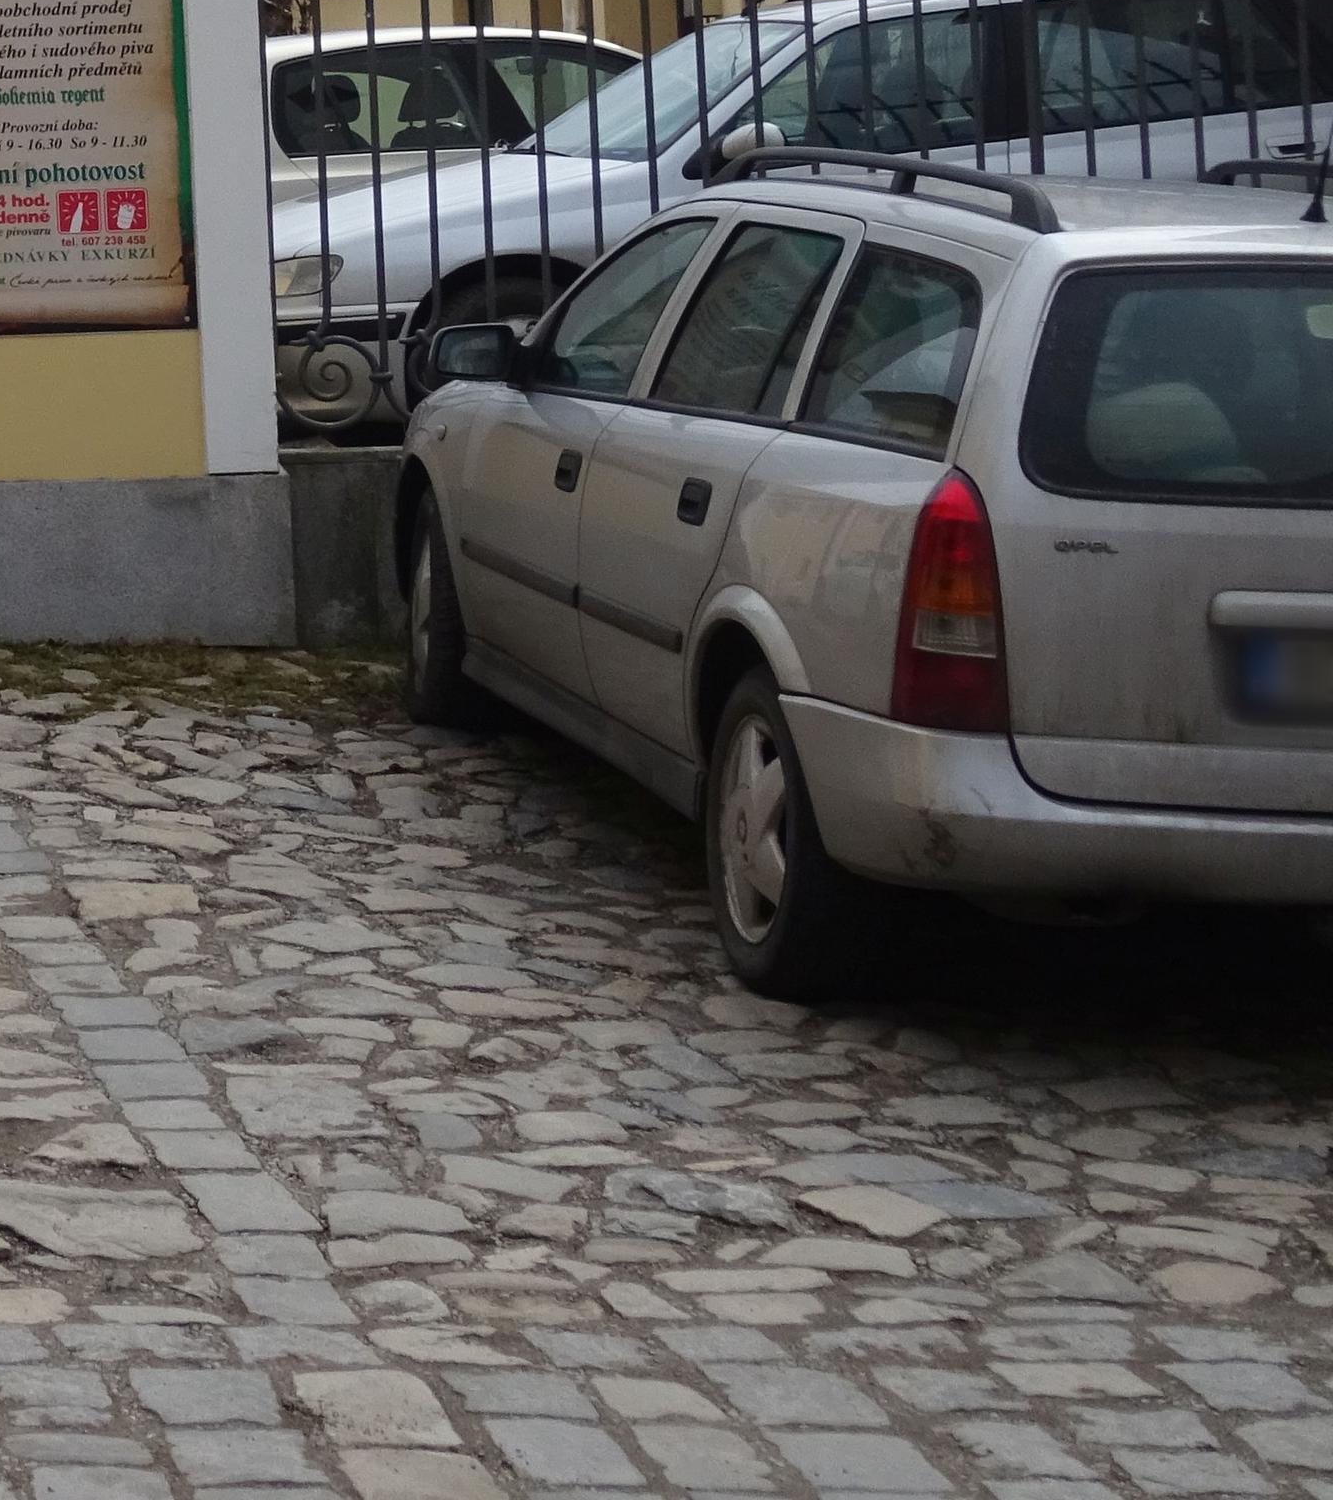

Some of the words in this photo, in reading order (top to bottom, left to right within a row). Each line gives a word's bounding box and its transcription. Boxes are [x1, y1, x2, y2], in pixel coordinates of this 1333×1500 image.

[81, 0, 133, 19] prodej
[57, 21, 143, 37] sortimentu
[31, 44, 38, 57] i
[41, 43, 116, 59] sudového
[119, 41, 155, 58] piva
[67, 61, 144, 81] předmětů
[0, 119, 60, 134] Provozní
[61, 118, 100, 132] doba:
[6, 139, 14, 152] 9
[27, 137, 64, 152] 16.30
[69, 137, 87, 150] So
[90, 137, 99, 150] 9
[25, 161, 146, 188] pohotovost
[11, 193, 51, 208] hod.
[5, 227, 52, 240] pivovaru
[81, 244, 157, 262] EXKURZÍ
[1053, 539, 1120, 555] OPEL
